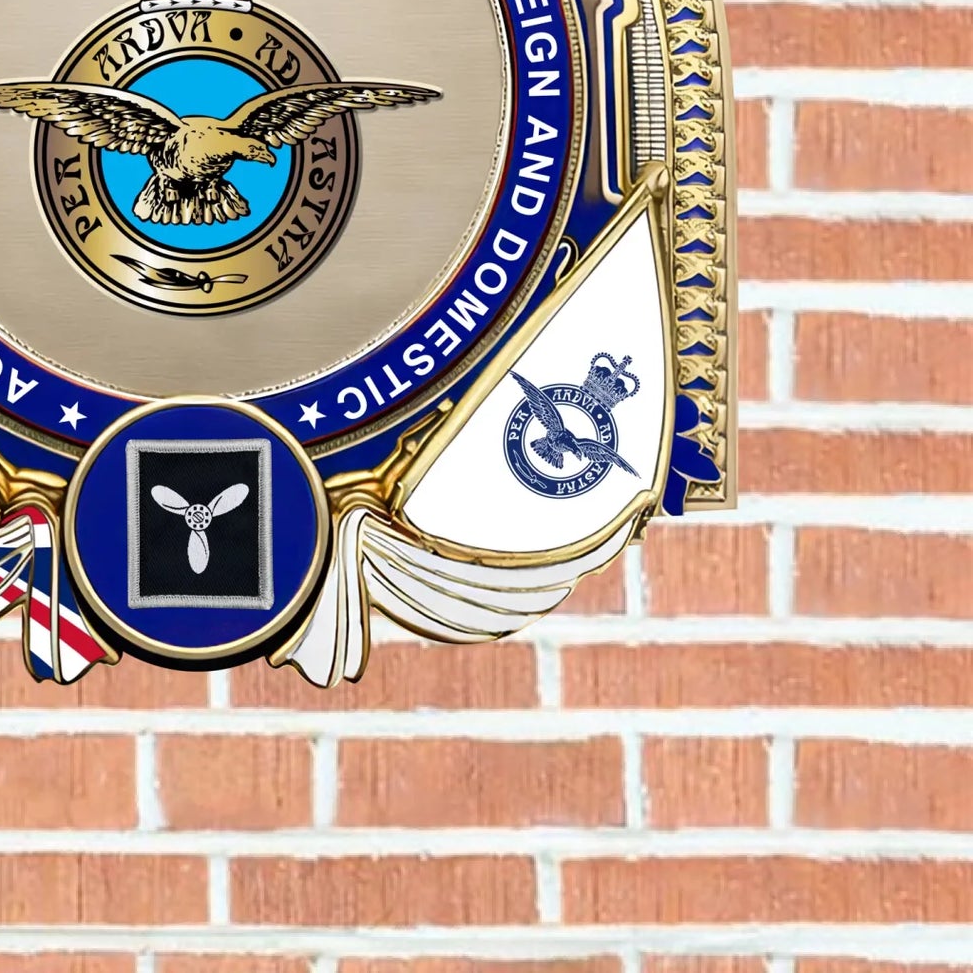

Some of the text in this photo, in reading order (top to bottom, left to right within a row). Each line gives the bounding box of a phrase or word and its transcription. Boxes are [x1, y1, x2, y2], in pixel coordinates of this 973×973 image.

[55, 152, 103, 243] PER
[255, 32, 301, 85] AD
[510, 114, 559, 217] AND
[335, 228, 529, 422] DOMESTIC
[508, 409, 529, 441] PER
